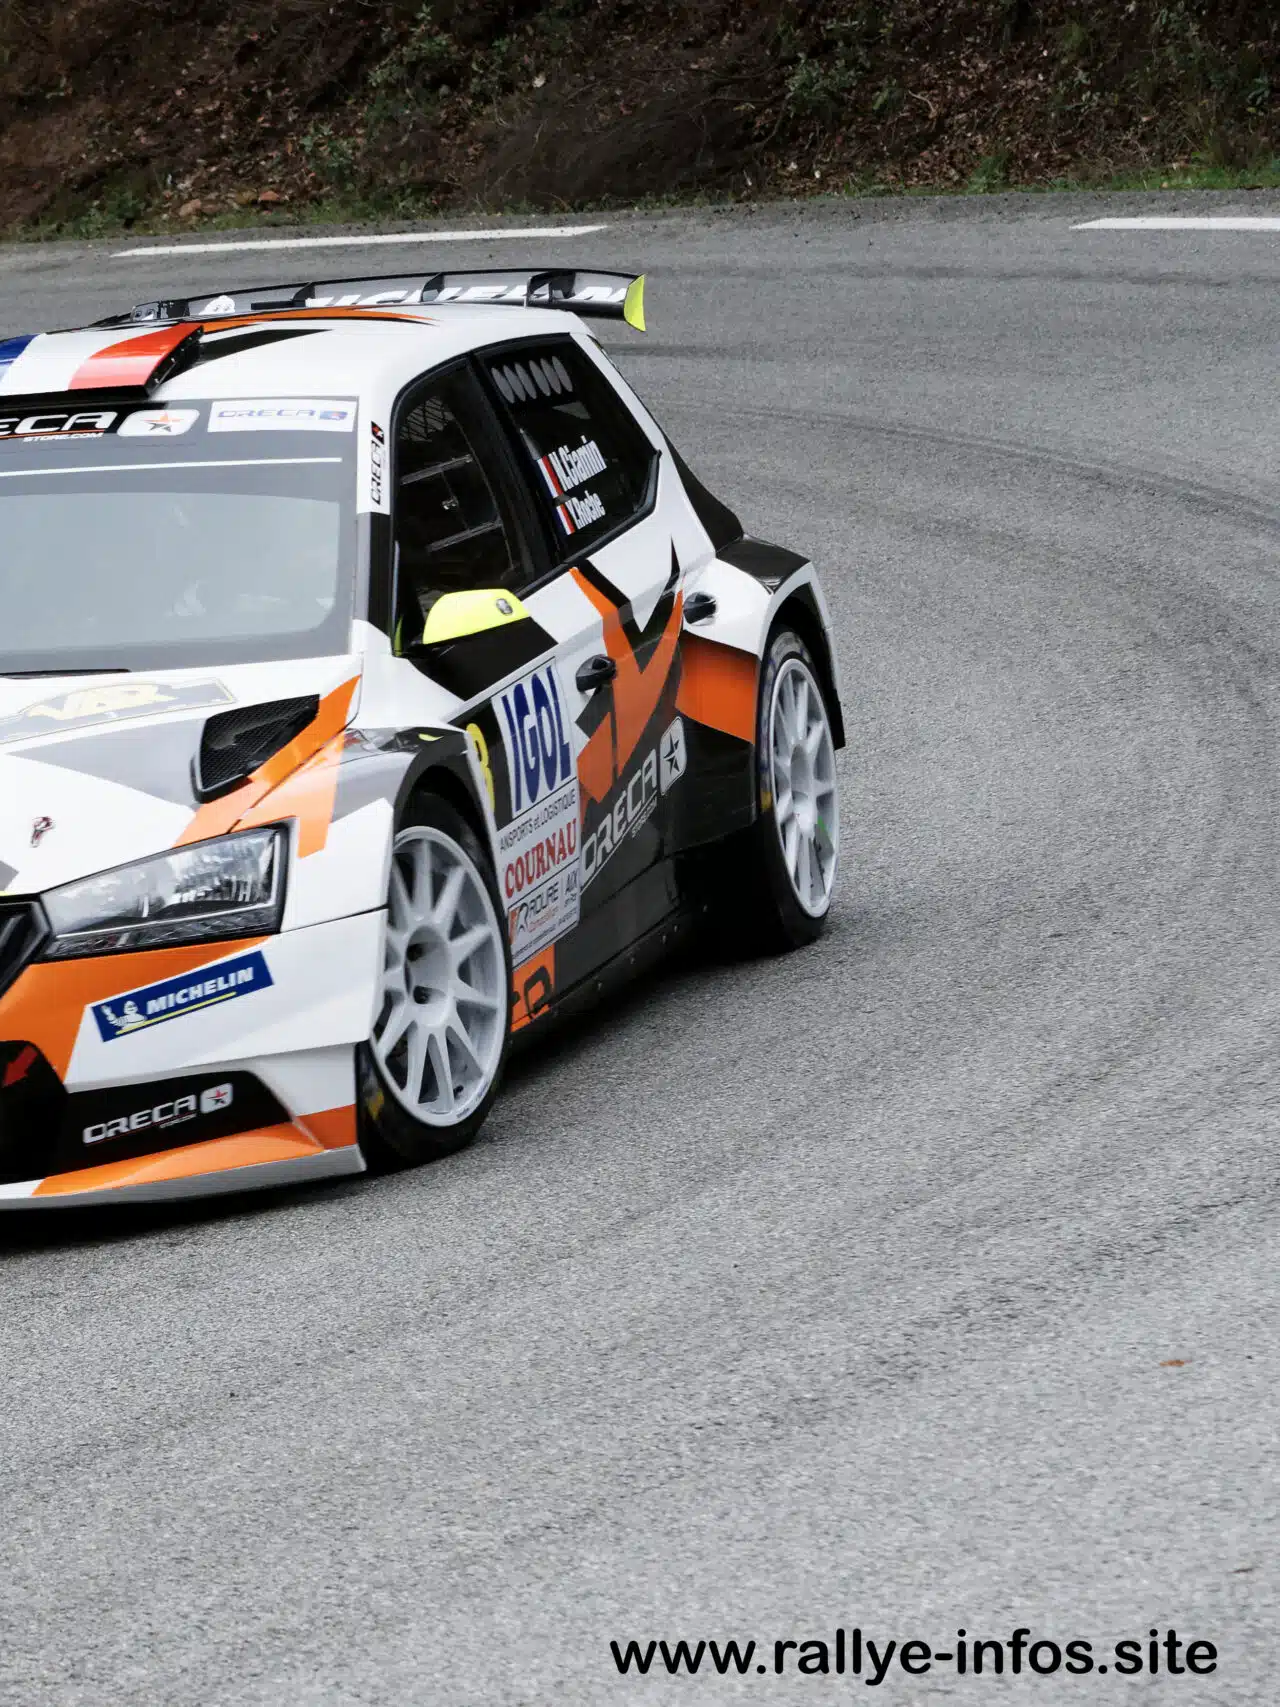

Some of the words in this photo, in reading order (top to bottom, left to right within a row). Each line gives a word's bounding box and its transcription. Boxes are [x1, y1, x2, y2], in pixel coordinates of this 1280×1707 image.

[218, 409, 316, 418] ORECA
[501, 665, 571, 813] IGOL
[581, 749, 657, 888] ORECA
[505, 818, 577, 899] COURNAU
[146, 966, 254, 1016] MICHELIN
[82, 1094, 197, 1144] ORECA
